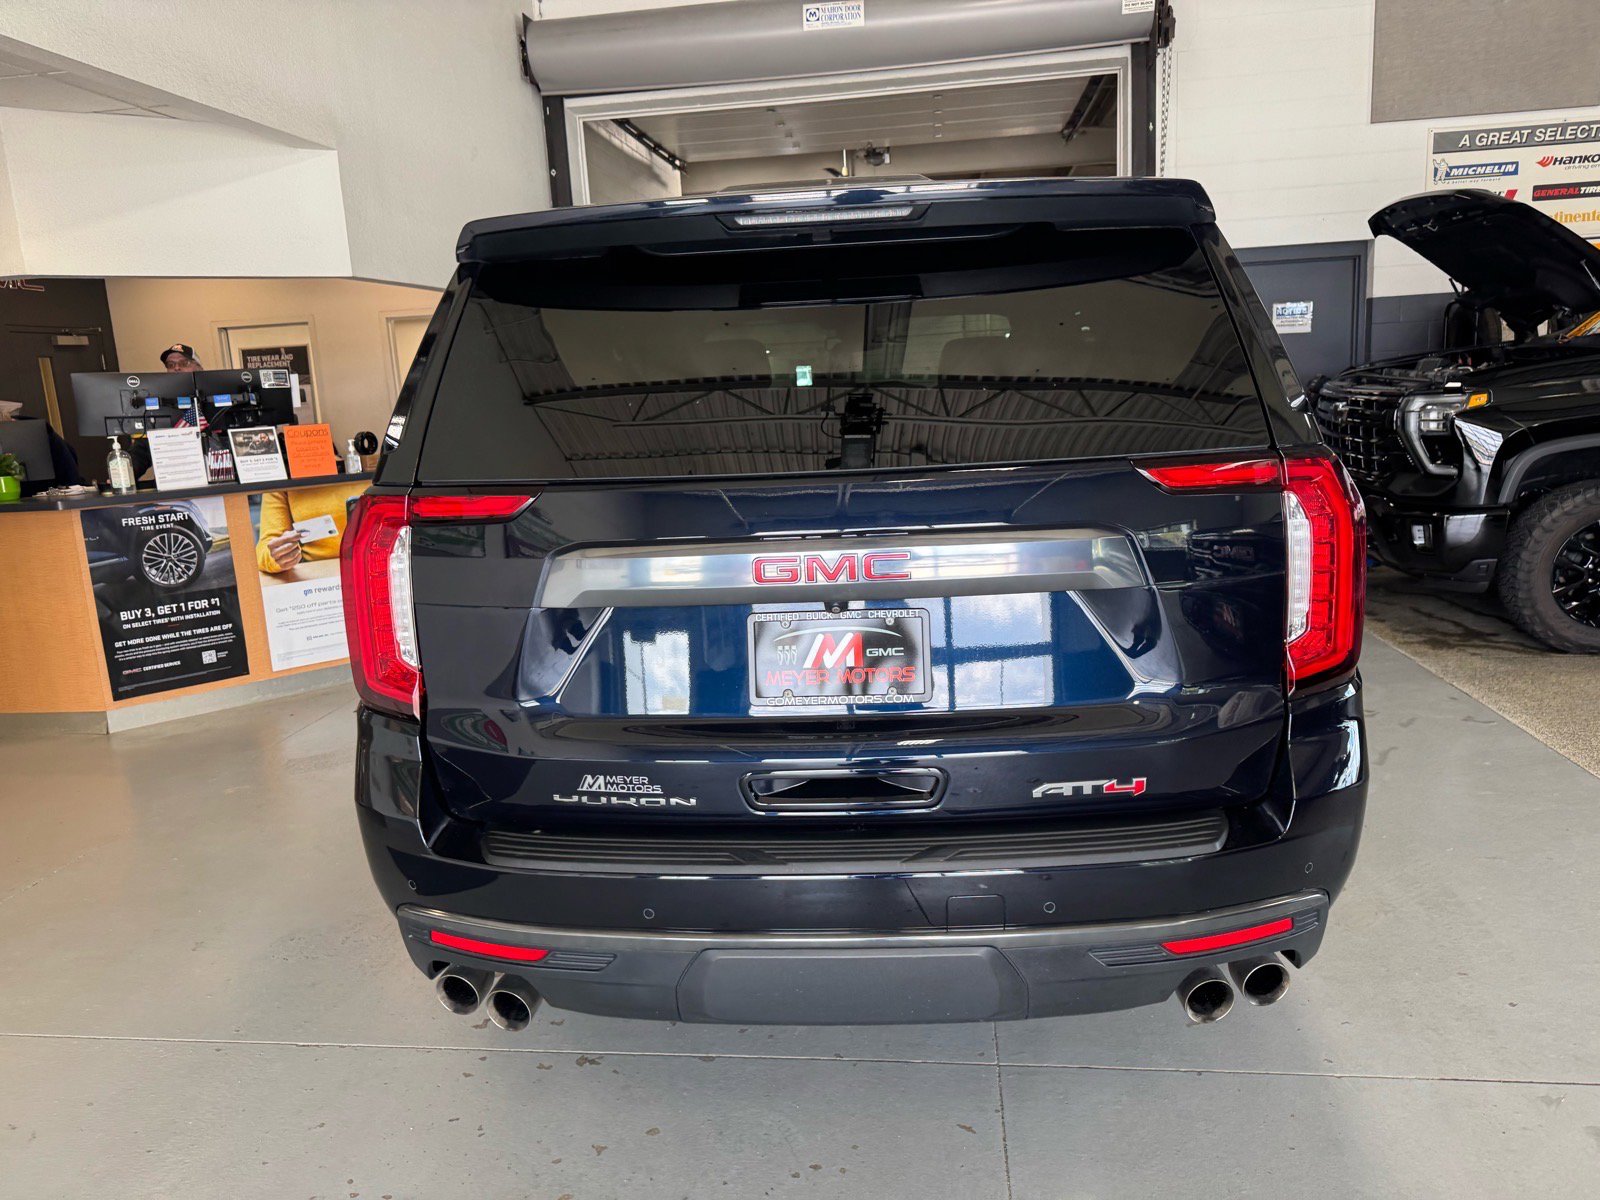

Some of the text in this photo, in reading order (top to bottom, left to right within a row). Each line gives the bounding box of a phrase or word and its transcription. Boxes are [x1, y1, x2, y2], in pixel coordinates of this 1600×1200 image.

[820, 12, 862, 22] CORPORATION
[1458, 124, 1600, 148] A GREAT SELECT
[1450, 164, 1516, 176] MICHELIN
[1534, 186, 1580, 197] GENERAL
[248, 360, 290, 368] REPLACEMENT
[122, 512, 190, 527] FRESH START
[752, 552, 912, 586] GMC
[314, 584, 342, 594] reward
[120, 598, 220, 621] BUY 3, GET 1 FOR $1
[185, 610, 221, 620] INSTALLATION
[755, 609, 920, 622] CERTIFIED BUICK GMC CHEVROLET
[193, 627, 209, 635] TIRES
[866, 647, 904, 656] GMC
[142, 664, 164, 672] CERTIFIED
[766, 666, 916, 686] MEYER MOTORS
[766, 694, 914, 706] GOMEYERMOTORS.COM
[606, 776, 649, 784] MEYER
[606, 784, 662, 792] MOTORS
[1032, 776, 1148, 798] AT4
[552, 794, 697, 807] YUKON
